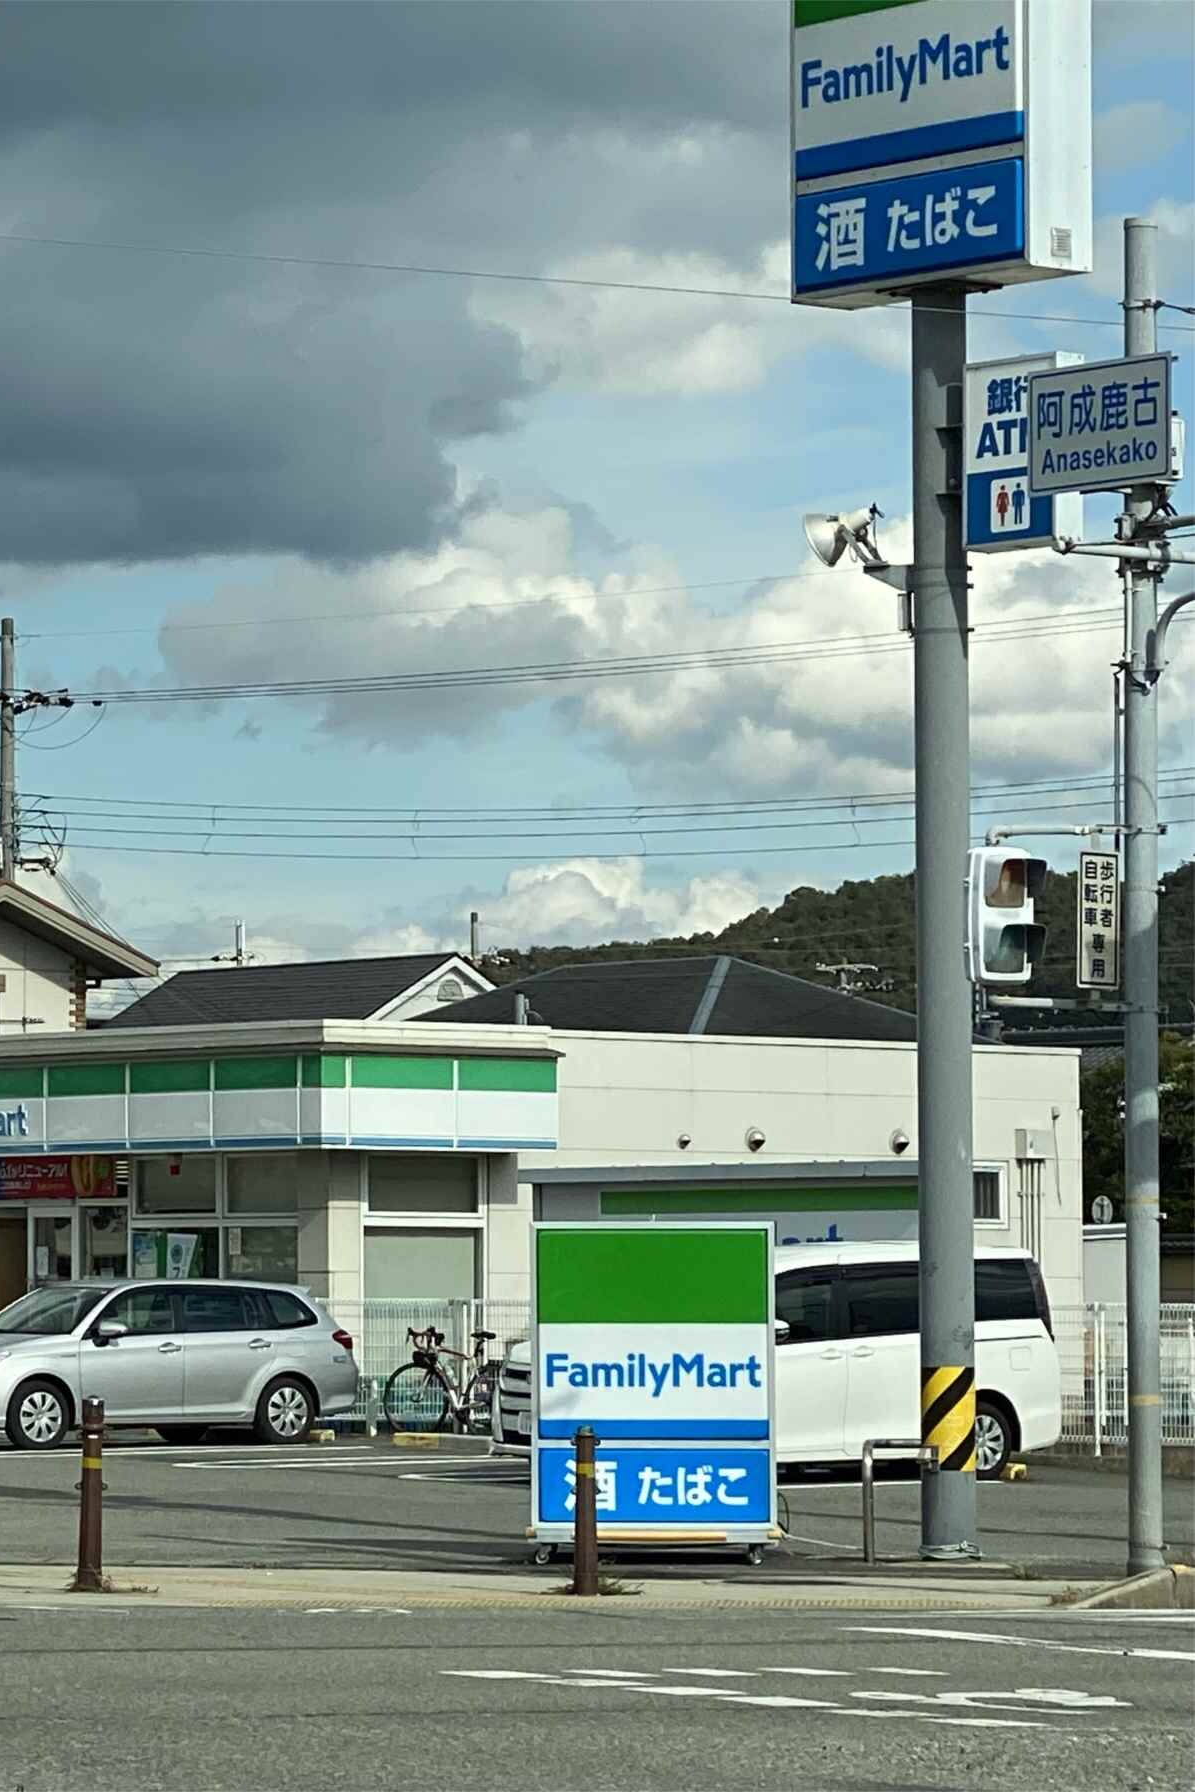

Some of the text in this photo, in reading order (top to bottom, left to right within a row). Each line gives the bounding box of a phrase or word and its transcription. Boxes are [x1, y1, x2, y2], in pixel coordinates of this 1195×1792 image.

[801, 26, 1010, 108] FamilyMart
[815, 185, 998, 272] 酒 たばこ
[1037, 377, 1160, 440] 阿成鹿古
[1041, 437, 1157, 475] Anasekako
[1084, 861, 1097, 927] 自転車
[1100, 861, 1114, 928] 歩行者
[1091, 934, 1105, 979] 専用
[545, 1353, 762, 1397] FamilyMart
[638, 1464, 748, 1506] たばこ
